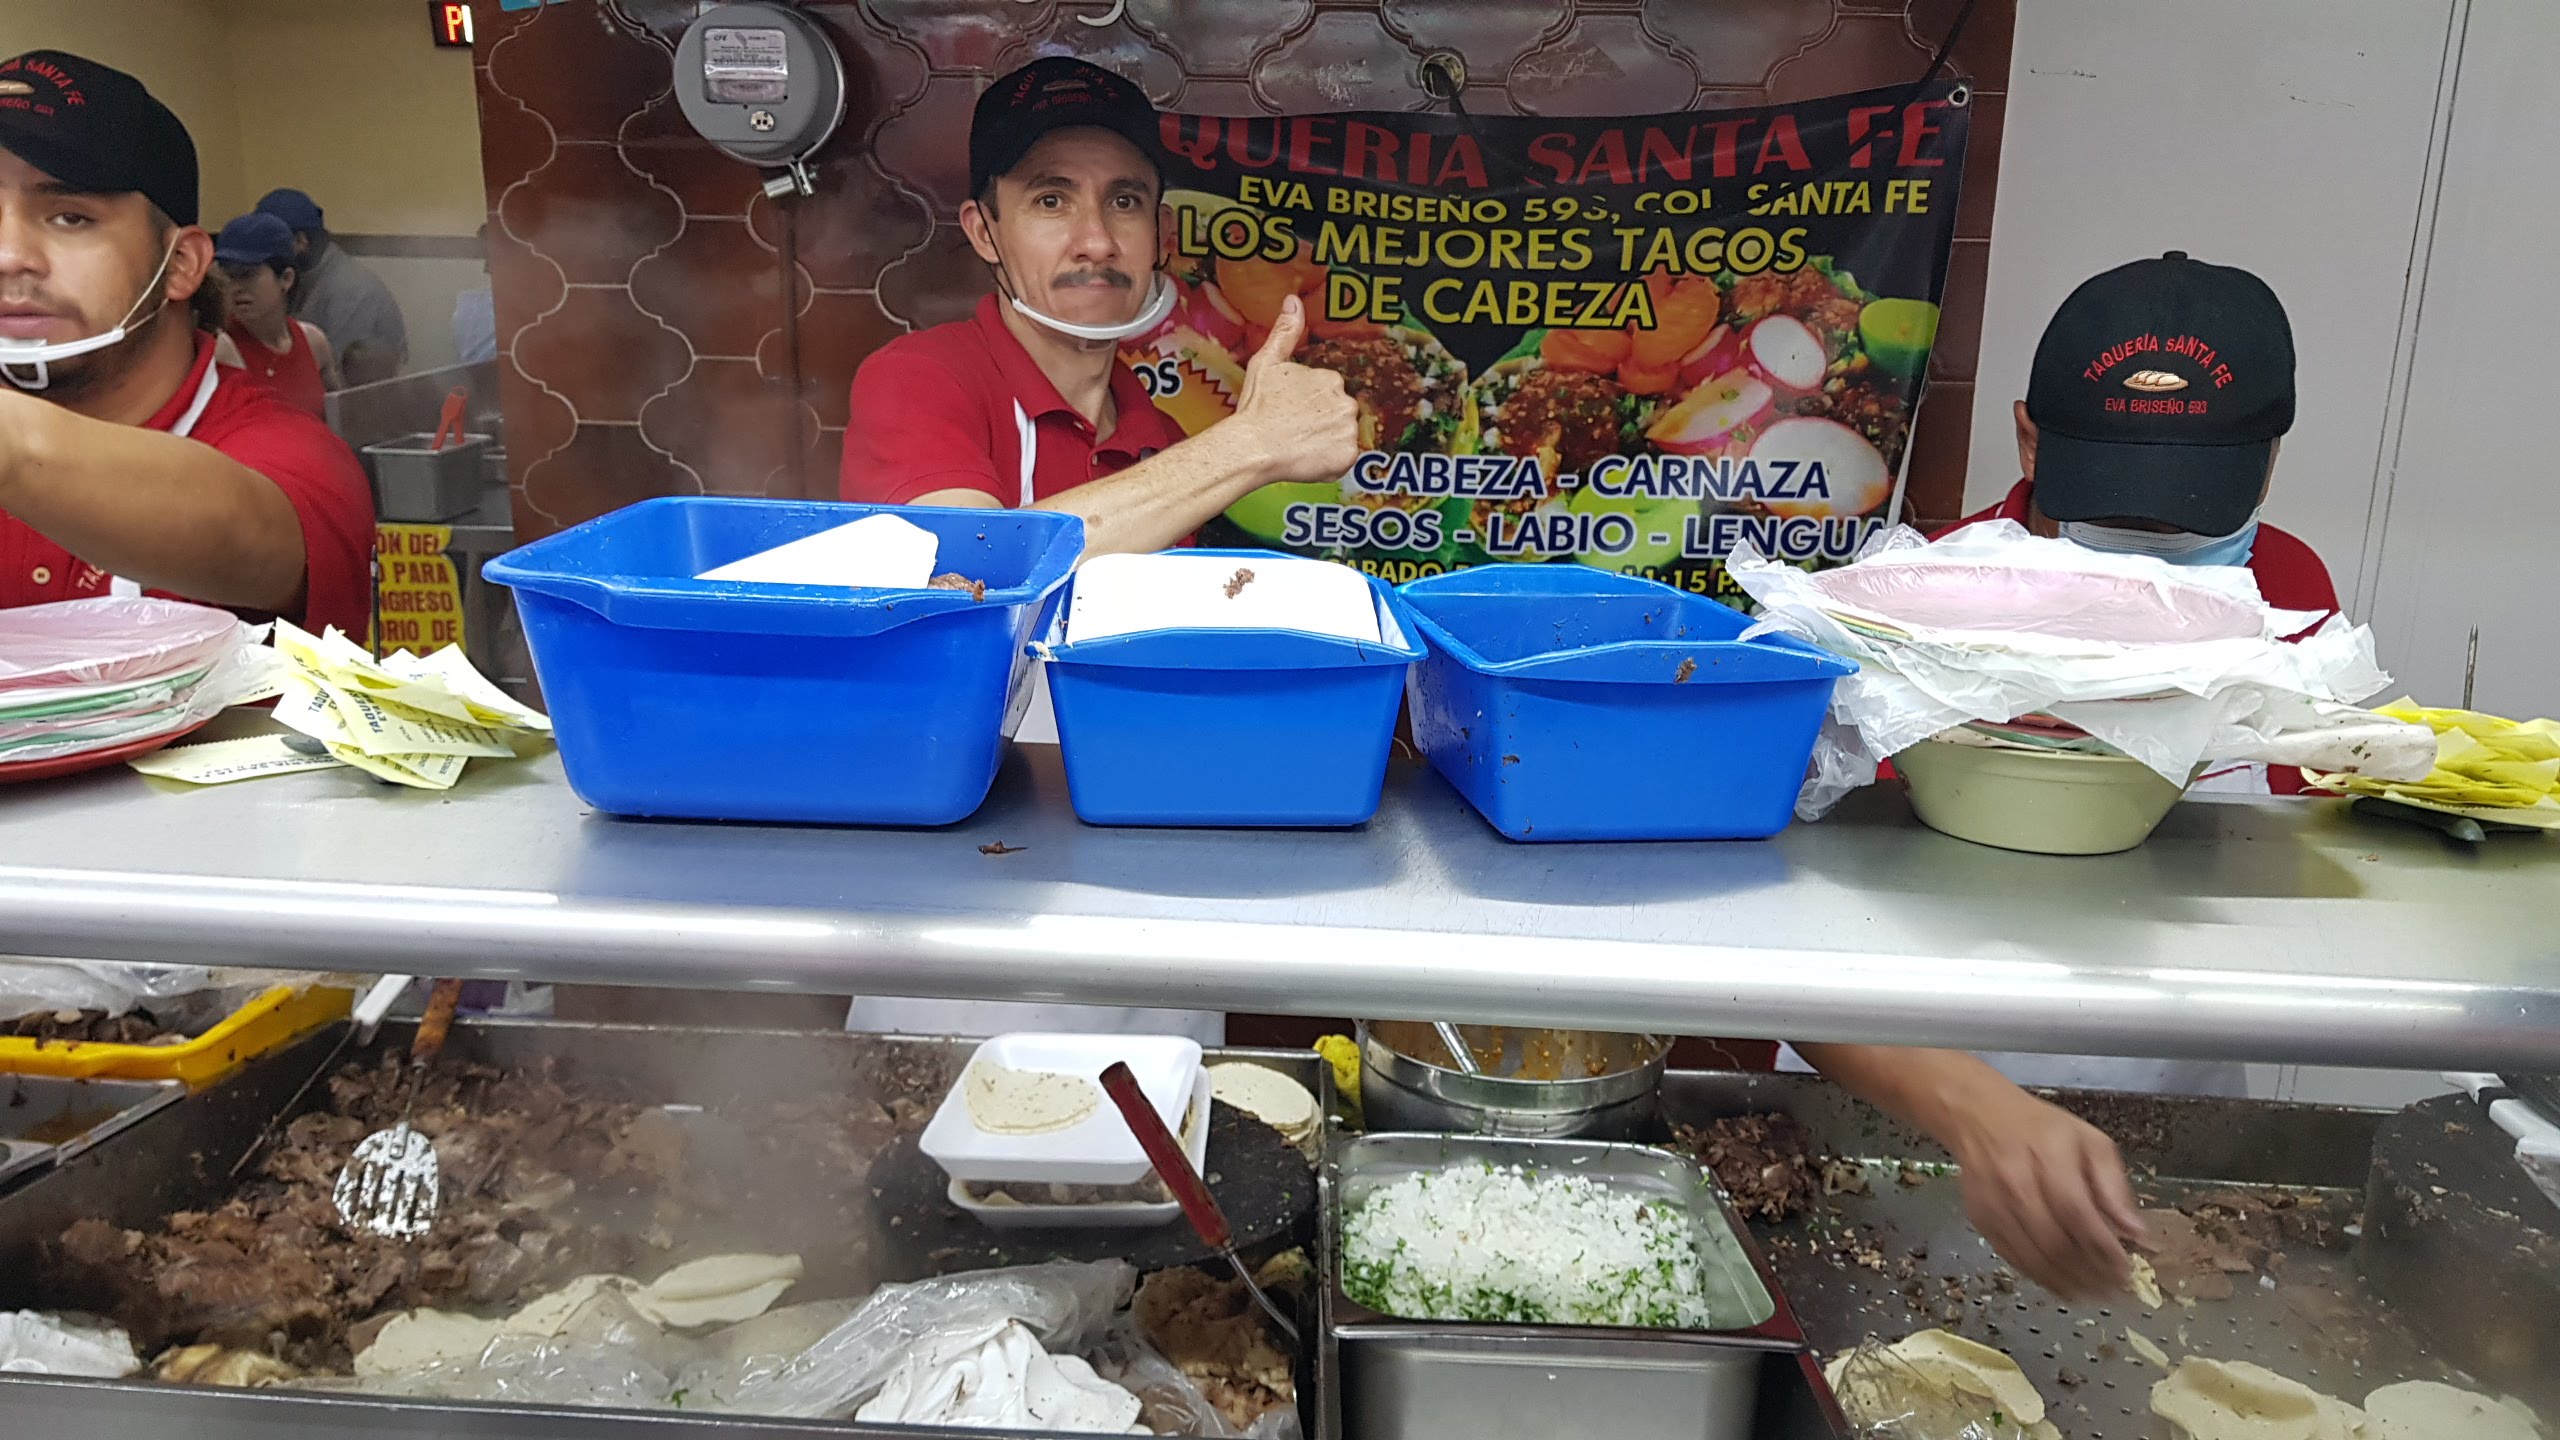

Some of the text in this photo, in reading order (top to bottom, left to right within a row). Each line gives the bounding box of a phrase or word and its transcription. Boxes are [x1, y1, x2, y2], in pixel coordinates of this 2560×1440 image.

[1524, 115, 1813, 189] SANTA
[1847, 99, 1949, 169] FE
[1240, 175, 1314, 211] EVA
[1327, 187, 1507, 224] BRISEÑO
[1746, 180, 1872, 216] SANTA
[1884, 179, 1932, 214] FE
[1181, 208, 1808, 273] LOS MEJORES TACOS
[1329, 274, 1656, 327] DE CABEZA
[2165, 335, 2218, 369] SANTA
[2210, 363, 2234, 390] FE
[2105, 398, 2208, 415] EVA BRISEÑO 593
[1353, 453, 1545, 496] CABEZA
[1591, 457, 1830, 499] CARNAZA
[1284, 504, 1441, 548] SESOS
[1488, 514, 1634, 553] LABIO
[394, 561, 449, 584] PARA
[432, 620, 457, 642] DE
